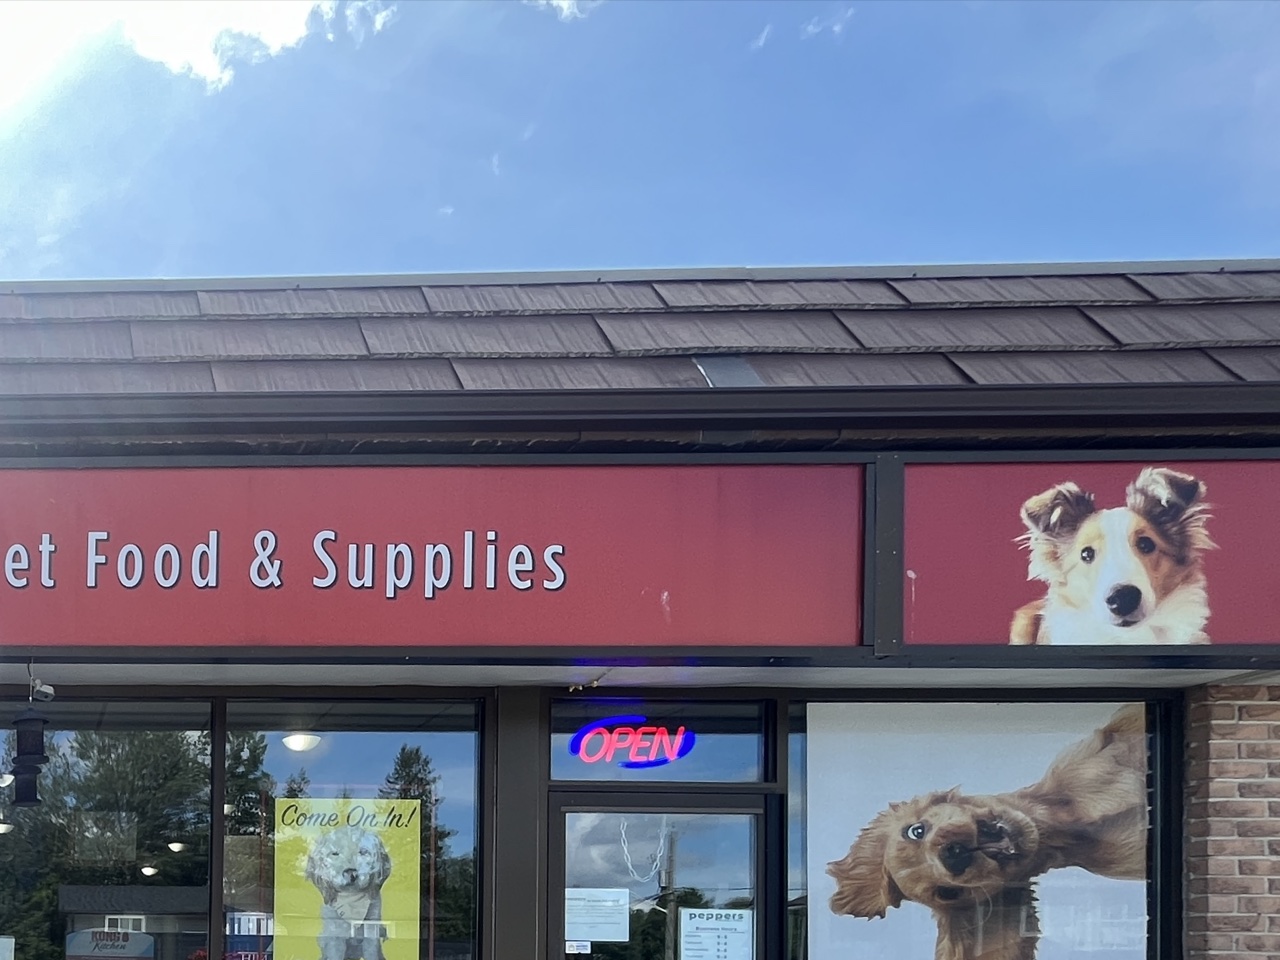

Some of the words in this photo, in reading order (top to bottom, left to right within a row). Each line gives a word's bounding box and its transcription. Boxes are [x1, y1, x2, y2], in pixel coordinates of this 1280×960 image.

[86, 530, 220, 590] Food
[249, 530, 283, 589] &
[311, 530, 567, 600] Supplies
[579, 726, 687, 764] OPEN
[281, 804, 340, 827] Come
[346, 805, 378, 828] On
[383, 806, 417, 828] In!
[689, 912, 744, 921] peppers
